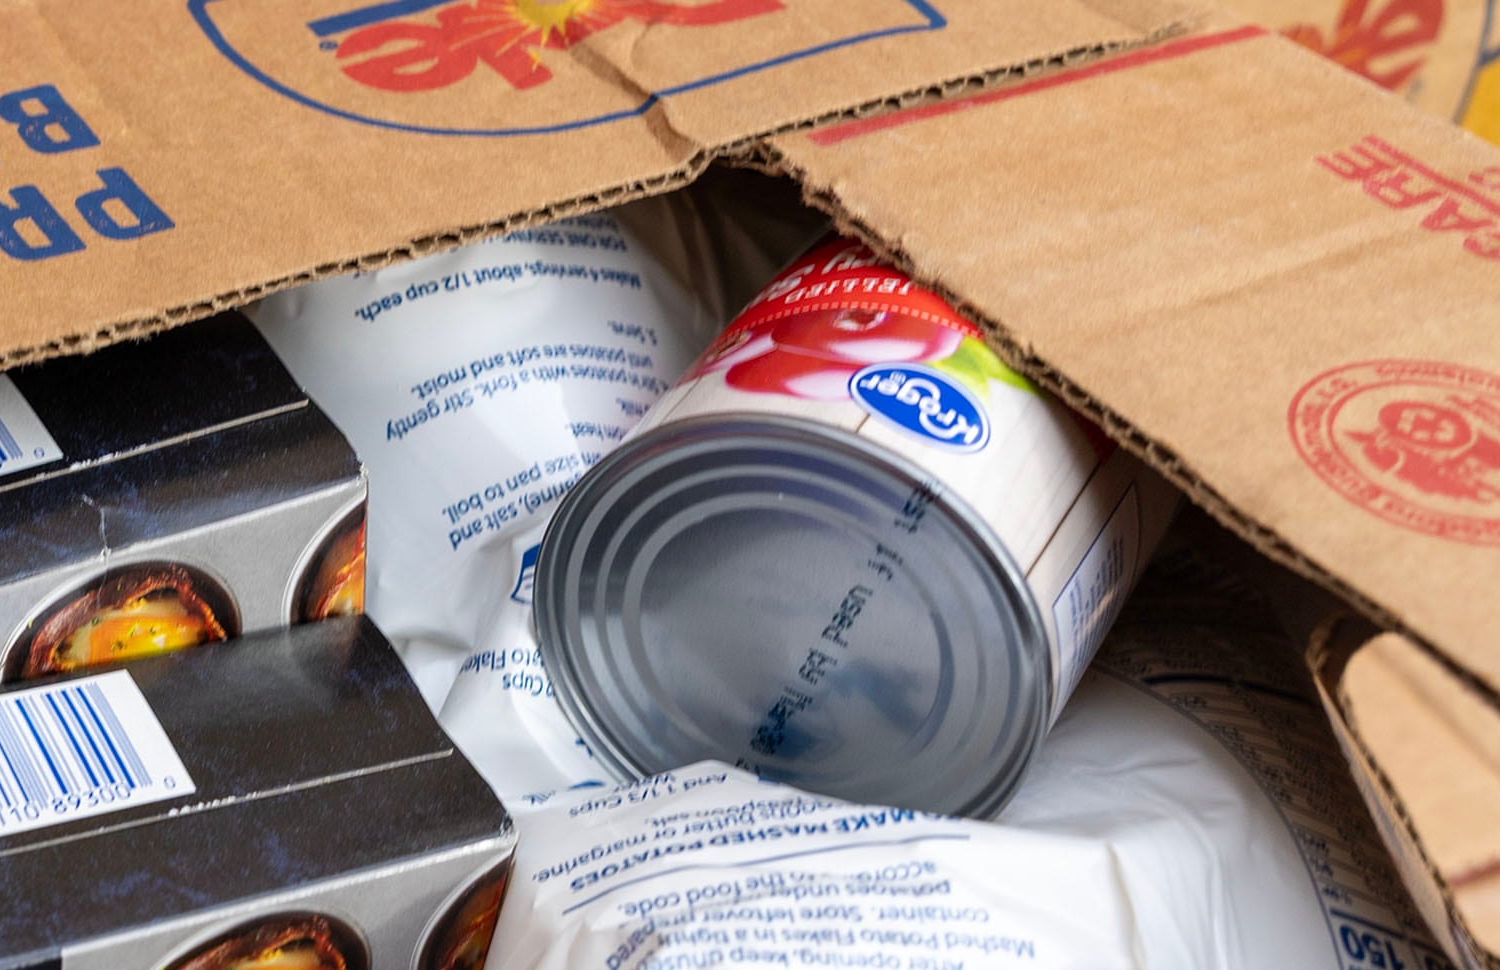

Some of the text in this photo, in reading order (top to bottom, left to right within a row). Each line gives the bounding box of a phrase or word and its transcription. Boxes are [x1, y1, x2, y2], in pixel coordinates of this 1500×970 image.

[468, 264, 524, 285] about
[524, 260, 592, 279] servings,
[400, 281, 439, 302] cup
[435, 273, 471, 292] 1/2
[354, 293, 403, 319] each.
[500, 346, 541, 366] soft
[538, 344, 568, 358] are
[460, 355, 504, 379] and
[532, 365, 573, 381] with
[411, 368, 467, 396] moist.
[474, 375, 518, 395] fork.
[444, 391, 474, 412] Stir
[858, 369, 982, 444] Kroger
[386, 405, 440, 439] gently
[501, 464, 542, 494] pan
[484, 482, 506, 501] to
[442, 492, 488, 518] boil.
[448, 500, 522, 548] salt and
[502, 666, 544, 697] Cups
[834, 806, 919, 833] MAKE
[708, 823, 828, 846] MASHED
[570, 841, 703, 891] POTATOES
[618, 892, 681, 916] code.
[685, 882, 743, 907] food
[701, 905, 989, 923] container. Store leftover
[781, 928, 855, 946] Flakes
[859, 929, 939, 949] Potato
[944, 931, 1035, 958] Mashed
[729, 946, 789, 966] keep
